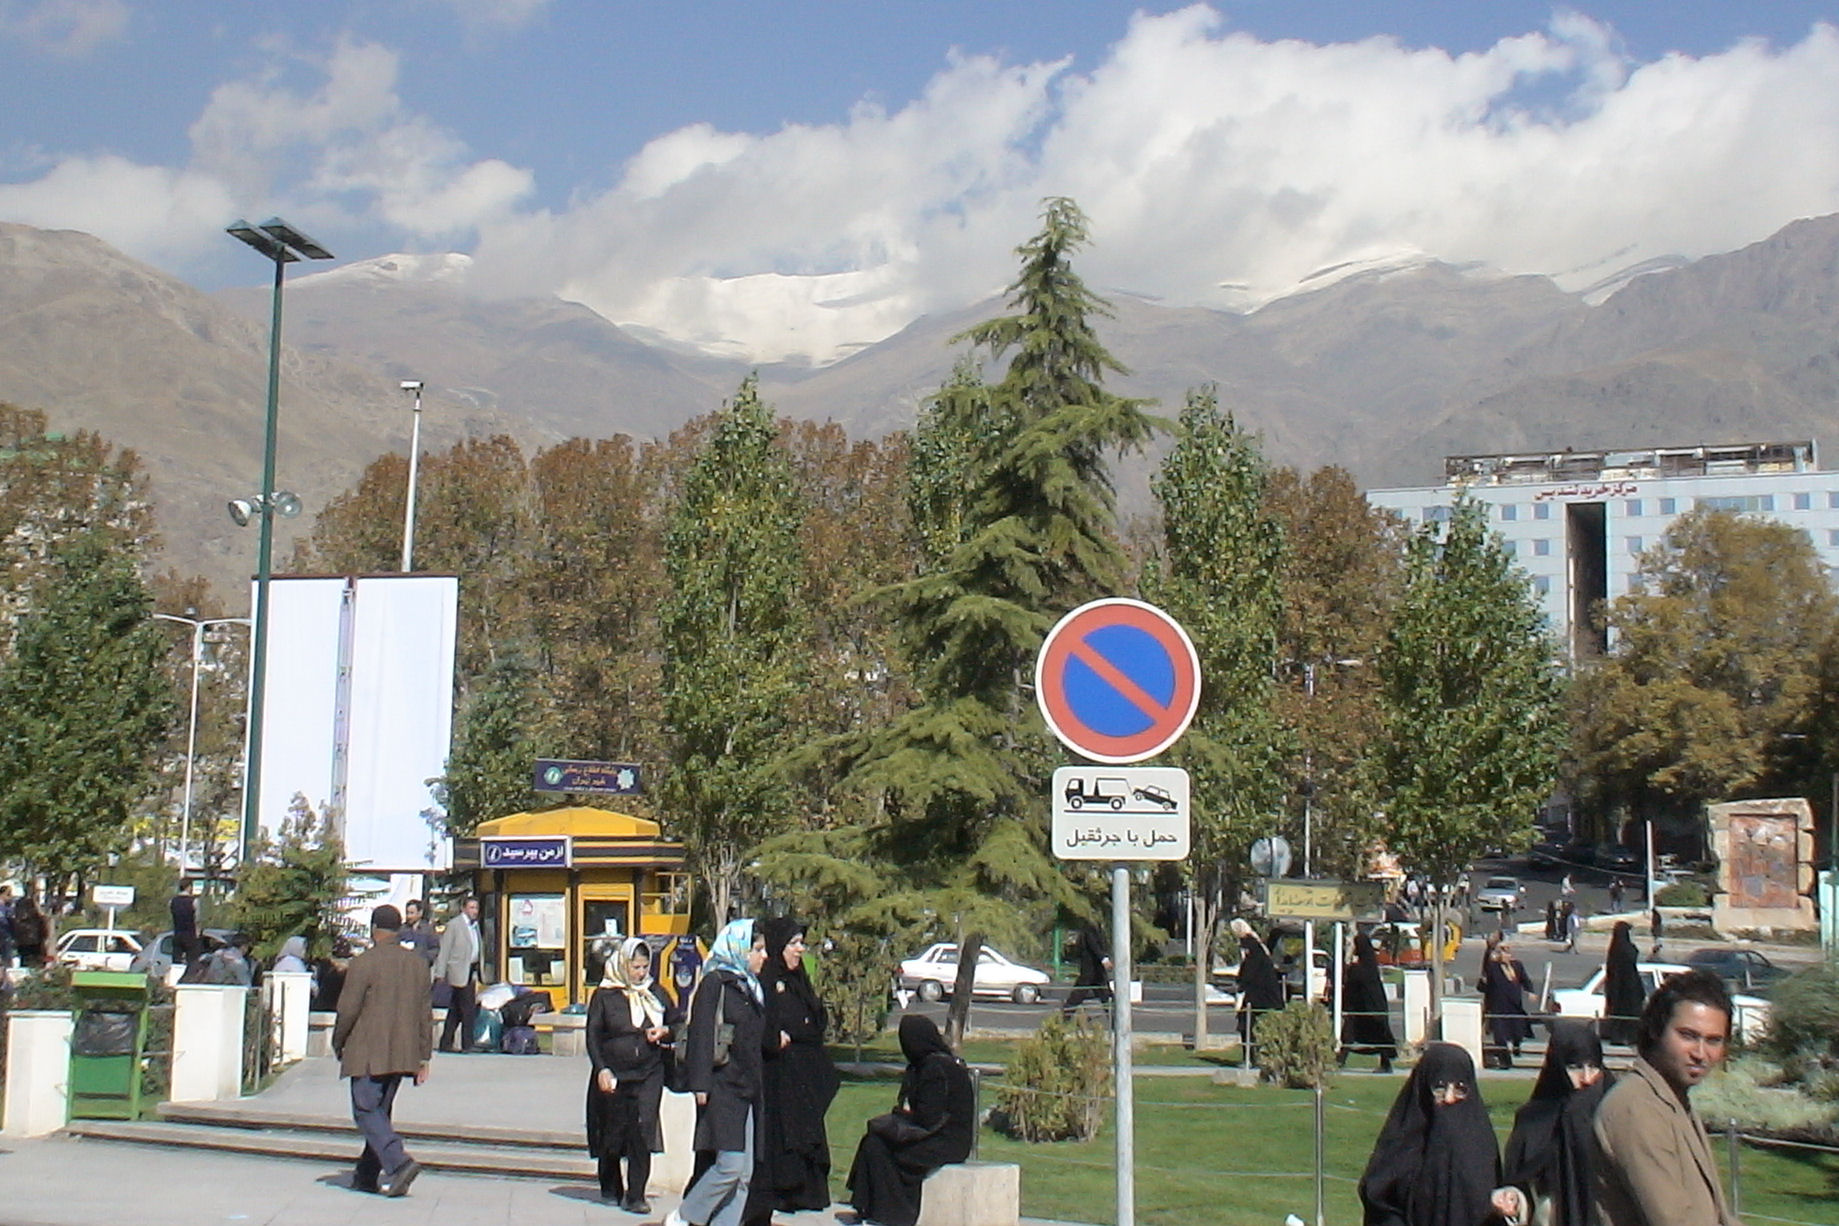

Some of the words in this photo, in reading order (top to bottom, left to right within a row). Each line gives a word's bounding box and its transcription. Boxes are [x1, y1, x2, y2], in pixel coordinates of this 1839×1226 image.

[1581, 483, 1610, 499] خرید
[1610, 482, 1638, 497] مرکز
[1066, 827, 1121, 848] جرثقیل
[1127, 829, 1139, 847] با
[1143, 829, 1178, 848] حمل
[502, 847, 538, 861] بپرسید
[538, 847, 555, 861] من
[554, 845, 564, 860] از
